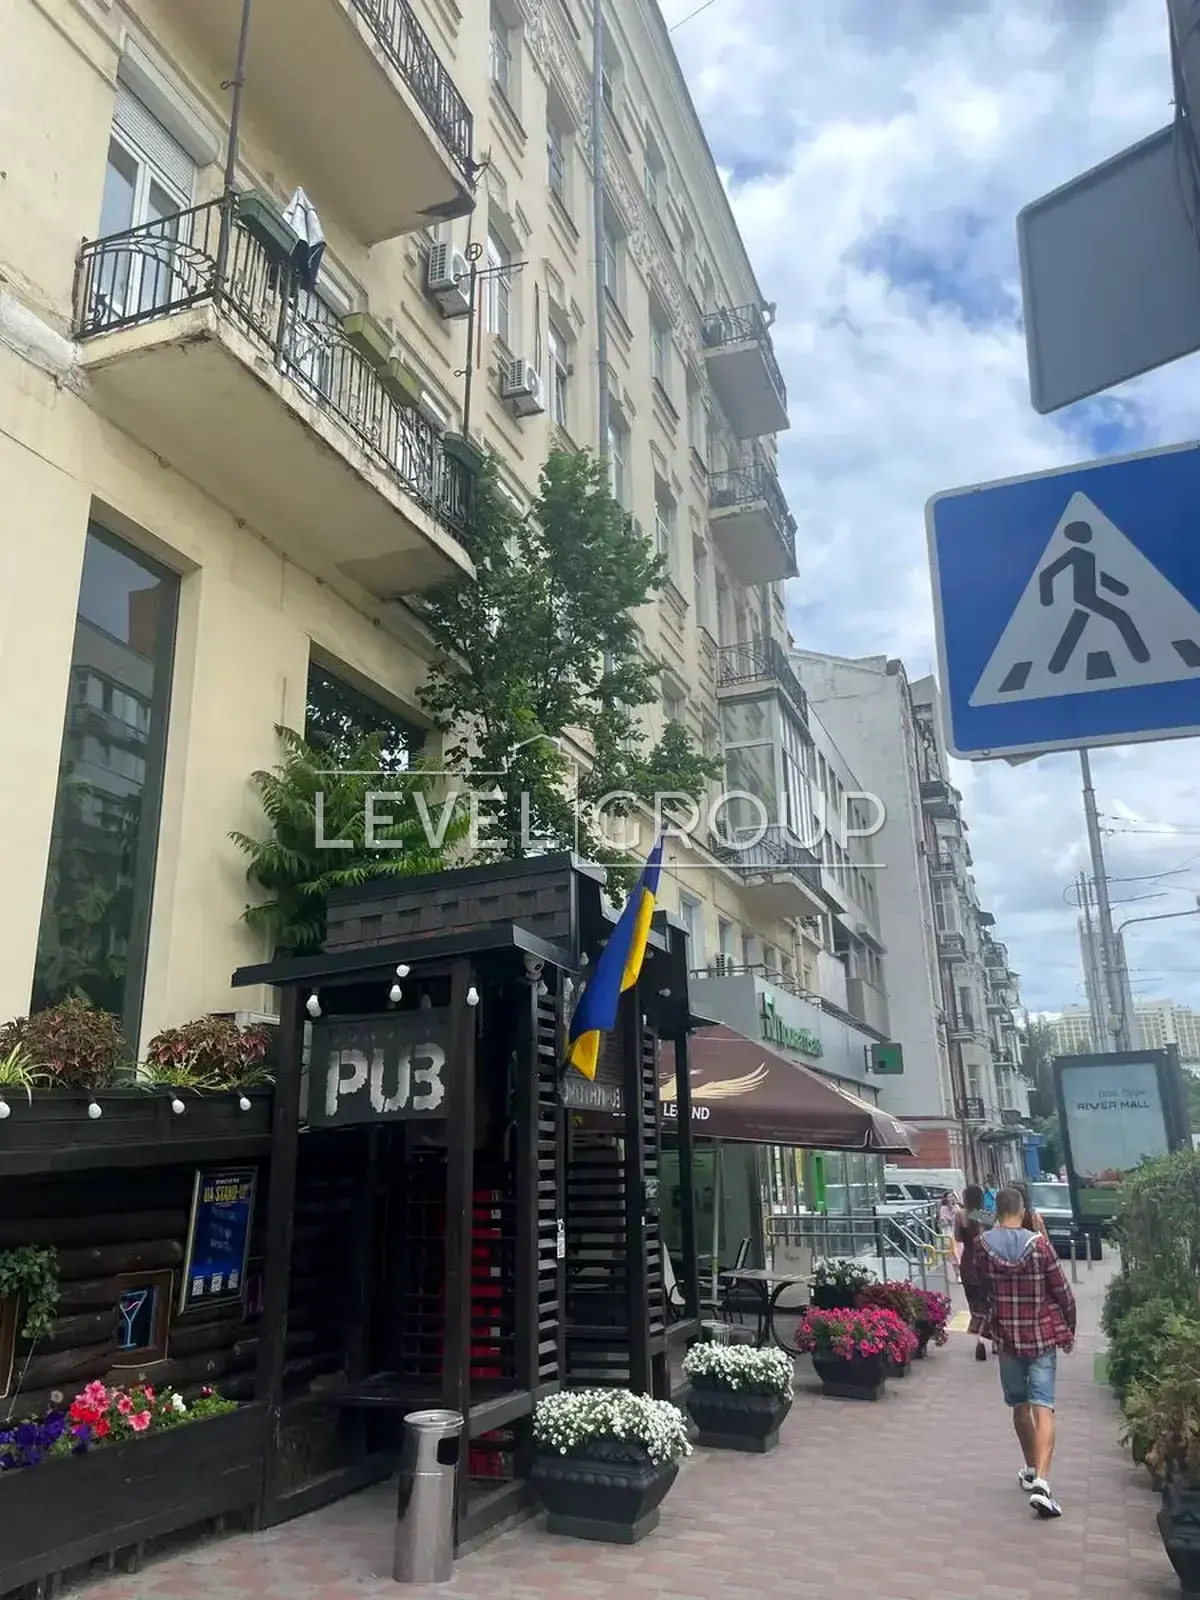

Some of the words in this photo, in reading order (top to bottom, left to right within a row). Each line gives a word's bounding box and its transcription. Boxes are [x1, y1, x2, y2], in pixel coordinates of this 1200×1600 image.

[325, 1042, 446, 1116] PUB
[662, 1102, 711, 1120] LEND
[1120, 1100, 1151, 1109] MALL
